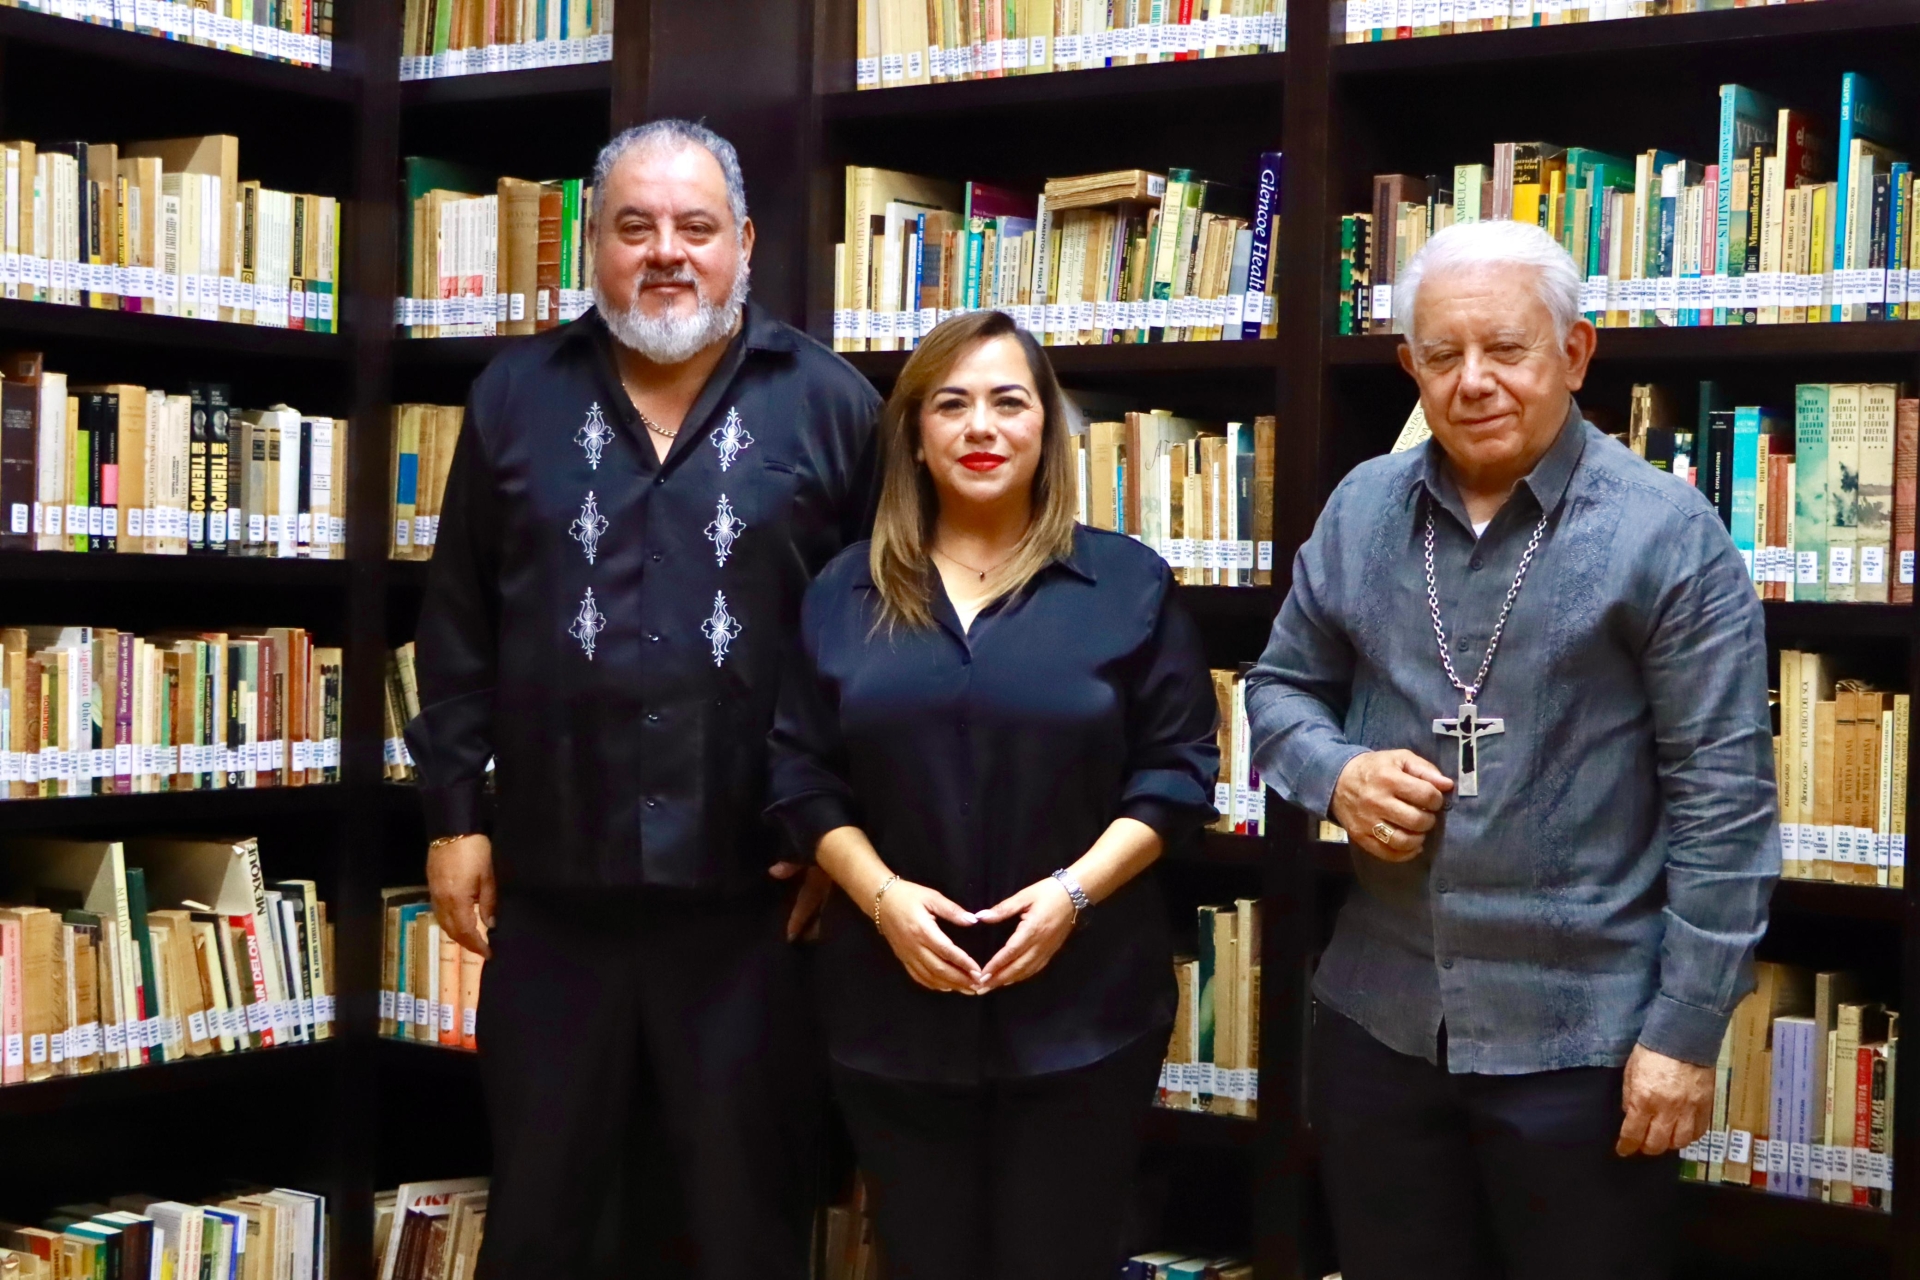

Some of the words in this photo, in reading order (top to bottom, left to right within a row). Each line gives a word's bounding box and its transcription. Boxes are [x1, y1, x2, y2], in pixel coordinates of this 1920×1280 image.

[1843, 77, 1851, 103] GATOS
[1721, 137, 1729, 175] ANDREAS
[1751, 147, 1761, 175] Tierra
[1751, 176, 1760, 184] la
[1751, 185, 1760, 196] de
[1255, 169, 1275, 237] Glencoe
[1457, 169, 1466, 223] AMBULOS
[1718, 179, 1730, 238] VESALIUS
[856, 200, 865, 249] CHIAPAS
[1749, 197, 1759, 247] Murmullos
[856, 251, 864, 265] DE
[1039, 256, 1044, 265] DE
[244, 274, 251, 283] 6
[293, 282, 300, 291] 4
[855, 268, 864, 297] AVES
[1065, 290, 1069, 298] de
[1077, 289, 1082, 297] de
[192, 442, 206, 454] MIS
[211, 443, 227, 455] MIS
[80, 650, 91, 697] Significant
[82, 702, 91, 731] Others
[1845, 740, 1853, 765] ESPAÑA
[1863, 739, 1871, 765] ESPAÑA
[1893, 773, 1899, 781] DE
[1894, 763, 1900, 771] LA
[1862, 768, 1870, 790] NUEVA
[1862, 794, 1869, 803] DE
[247, 845, 266, 916] MEXIQUE
[116, 887, 129, 938] MERIDA
[247, 935, 262, 981] DELON
[315, 968, 320, 978] MA
[1800, 1126, 1804, 1134] DE
